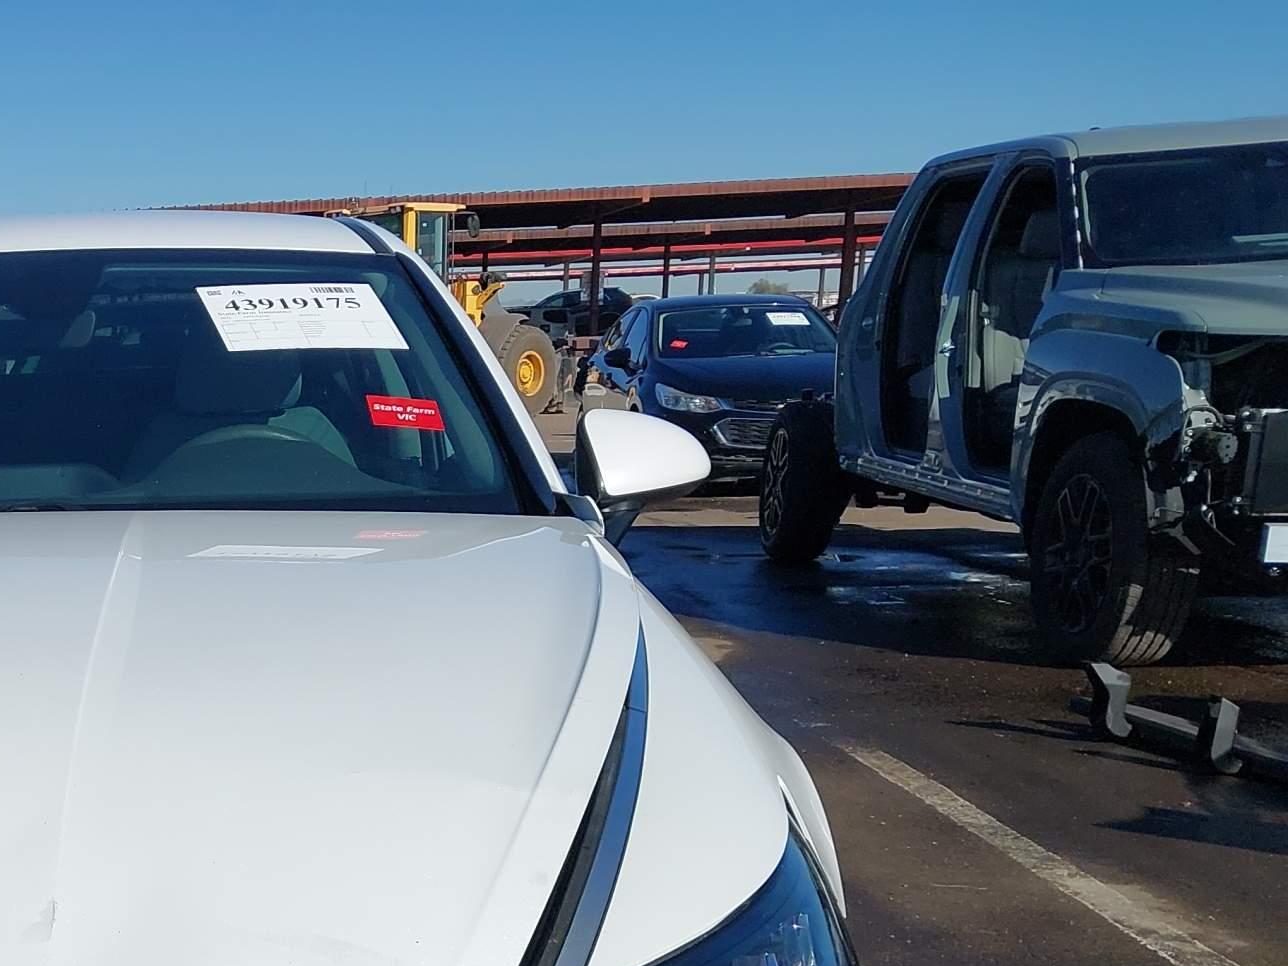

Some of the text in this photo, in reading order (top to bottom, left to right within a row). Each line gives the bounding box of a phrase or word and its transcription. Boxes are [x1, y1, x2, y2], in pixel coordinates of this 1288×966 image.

[224, 297, 362, 312] 43919175
[373, 403, 435, 415] State Farm
[397, 413, 417, 421] VIC
